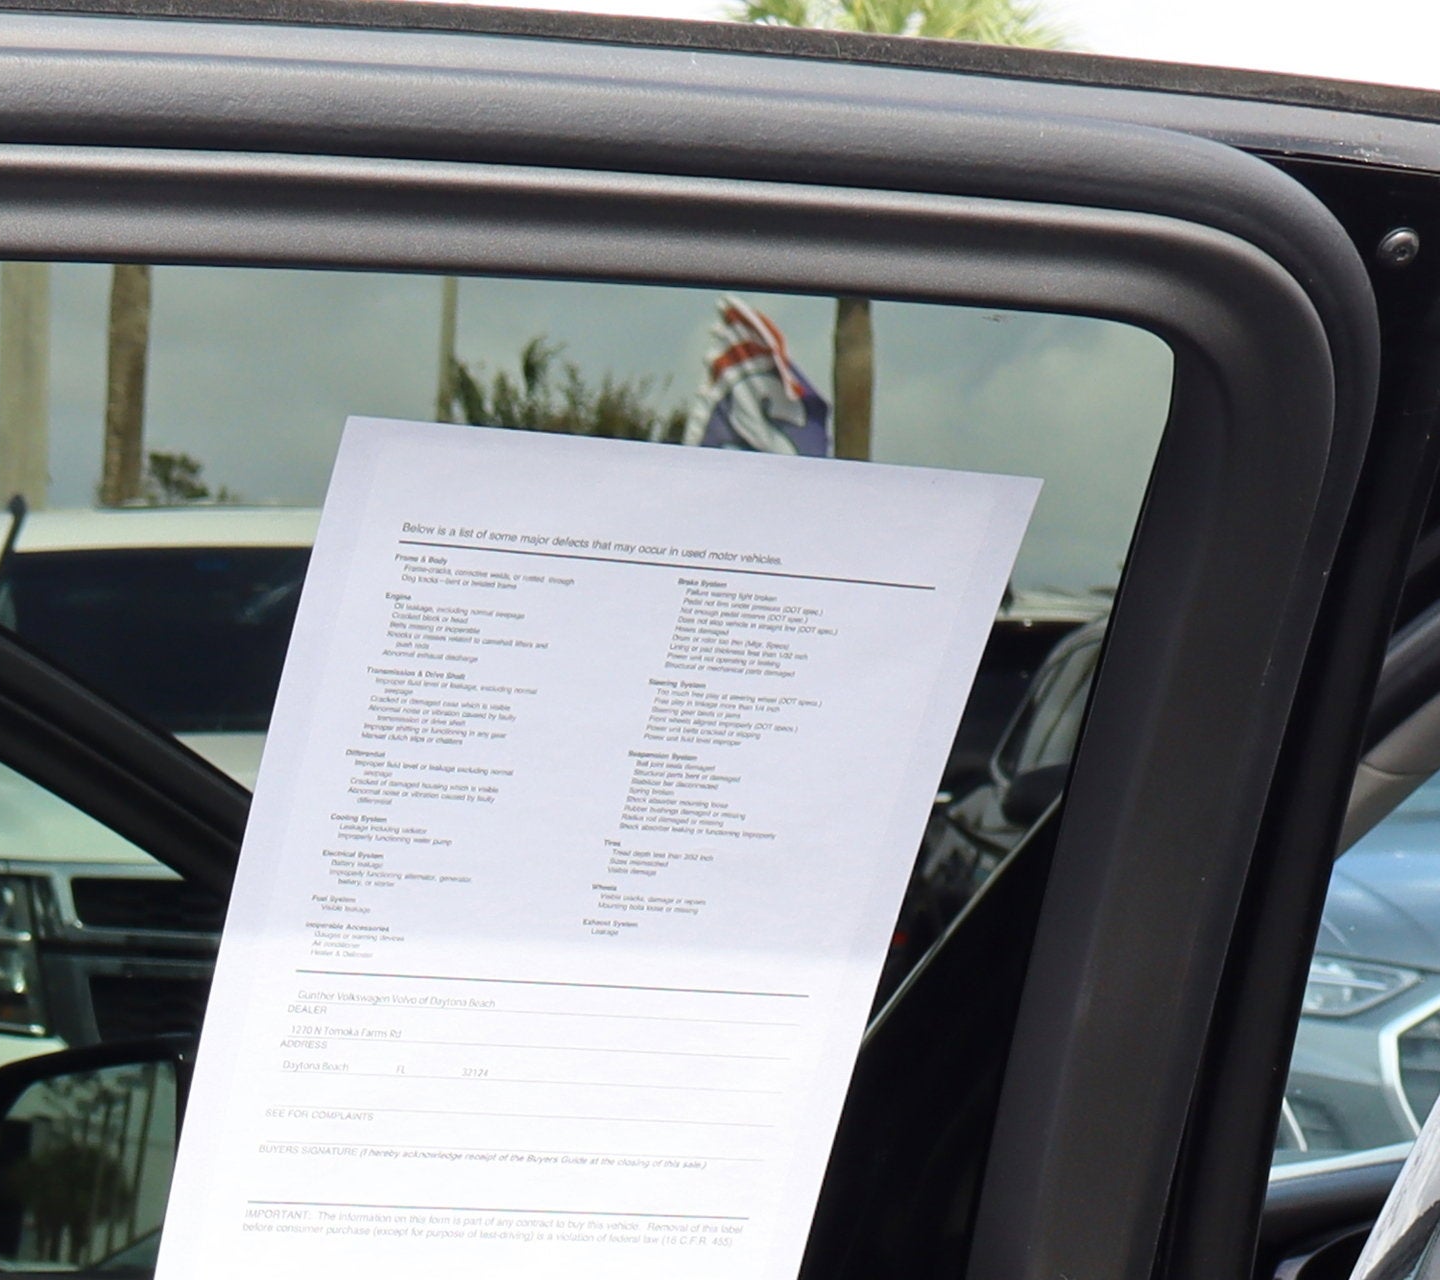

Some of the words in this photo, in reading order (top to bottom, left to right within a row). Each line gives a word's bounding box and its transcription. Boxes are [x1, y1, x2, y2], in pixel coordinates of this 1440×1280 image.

[402, 522, 435, 534] Below
[437, 525, 447, 535] is
[458, 527, 474, 538] list
[475, 529, 487, 539] of
[488, 532, 518, 542] some
[519, 532, 550, 547] major
[551, 535, 590, 548] defects
[591, 539, 612, 550] that
[612, 543, 636, 554] may
[637, 545, 666, 554] occur
[668, 545, 679, 555] in
[680, 546, 706, 558] used
[707, 549, 738, 561] motor
[297, 990, 335, 1000] Gunther
[336, 991, 390, 1004] Volkswagen
[391, 994, 417, 1003] Volvo
[417, 995, 428, 1004] of
[429, 996, 468, 1008] Daytona
[469, 998, 496, 1007] Beach
[286, 1004, 327, 1014] DEALER
[323, 1026, 360, 1036] Tomoka
[360, 1028, 388, 1037] Farms
[389, 1029, 402, 1038] Rd
[280, 1039, 328, 1049] ADDRESS
[282, 1060, 321, 1072] Daytona
[321, 1062, 349, 1071] Beach
[265, 1108, 286, 1117] SEE
[287, 1109, 309, 1118] FOR
[311, 1110, 374, 1120] COMPLAINTS
[258, 1144, 299, 1154] BUYERS
[301, 1146, 358, 1156] SIGNATURE
[368, 1148, 400, 1159] hereby
[464, 1151, 497, 1163] receipt
[498, 1153, 508, 1161] of
[509, 1154, 525, 1162] the
[525, 1154, 558, 1165] Buyers
[560, 1155, 588, 1164] Guide
[589, 1156, 599, 1165] at
[600, 1157, 615, 1165] the
[616, 1157, 650, 1168] closing
[652, 1159, 663, 1167] of
[663, 1159, 680, 1167] this
[318, 1211, 336, 1220] The
[338, 1212, 392, 1222] information
[408, 1214, 426, 1223] this
[428, 1214, 451, 1224] form
[452, 1215, 462, 1224] is
[463, 1215, 483, 1227] part
[484, 1217, 495, 1225] of
[495, 1219, 513, 1228] any
[515, 1218, 554, 1227] contract
[555, 1219, 565, 1227] to
[566, 1219, 585, 1230] buy
[586, 1220, 604, 1229] this
[647, 1222, 690, 1231] Removal
[690, 1223, 701, 1232] of
[702, 1223, 719, 1232] this
[720, 1224, 743, 1233] label
[241, 1222, 273, 1231] before
[275, 1225, 323, 1233] consumer
[325, 1225, 370, 1236] purchase
[371, 1226, 408, 1237] (except
[410, 1227, 424, 1236] for
[425, 1230, 464, 1239] purpose
[466, 1229, 478, 1237] of
[478, 1230, 534, 1241] test-driving)
[536, 1231, 544, 1240] is
[555, 1232, 595, 1241] violation
[596, 1233, 607, 1242] of
[607, 1234, 641, 1243] federal
[642, 1235, 660, 1243] law
